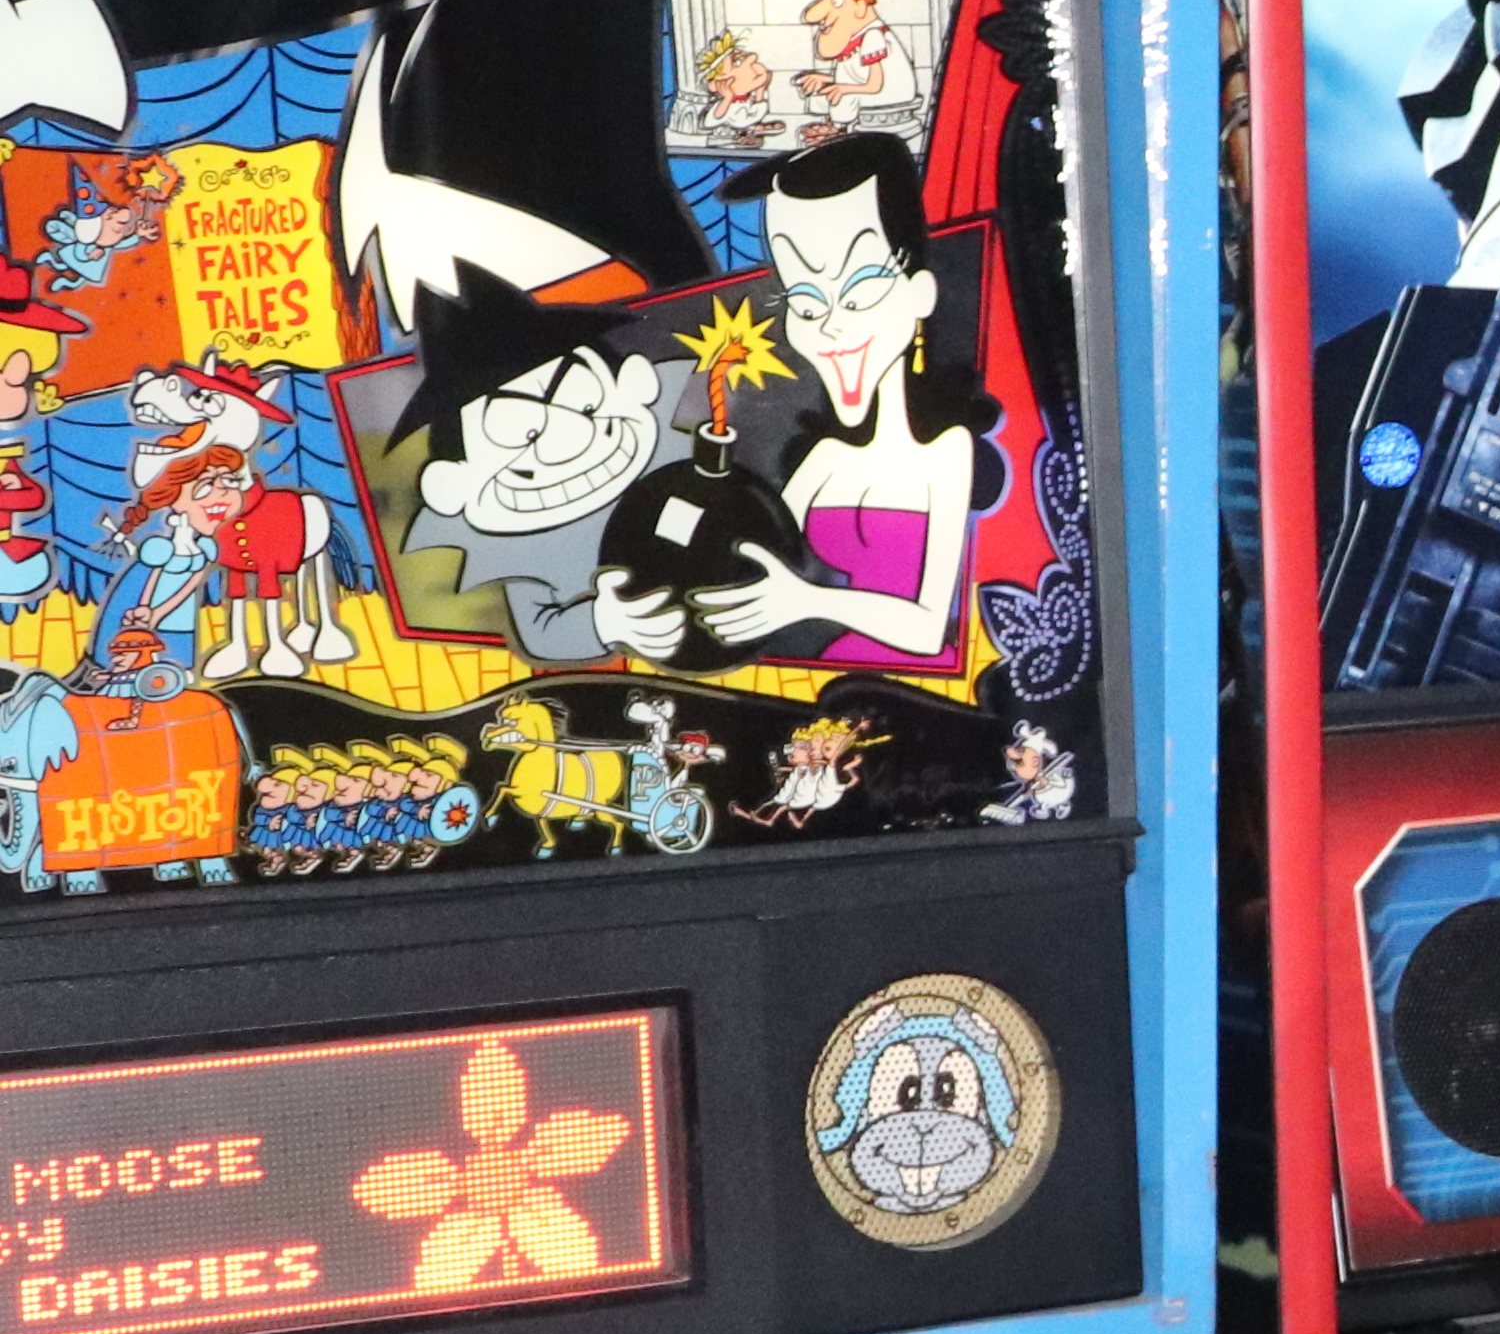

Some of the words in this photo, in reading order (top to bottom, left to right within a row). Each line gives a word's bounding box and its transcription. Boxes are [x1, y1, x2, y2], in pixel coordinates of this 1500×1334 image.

[184, 196, 308, 241] FRACTURED
[197, 280, 311, 334] TALES
[12, 1135, 267, 1207] MOOSE
[19, 1243, 322, 1323] DAISIES
